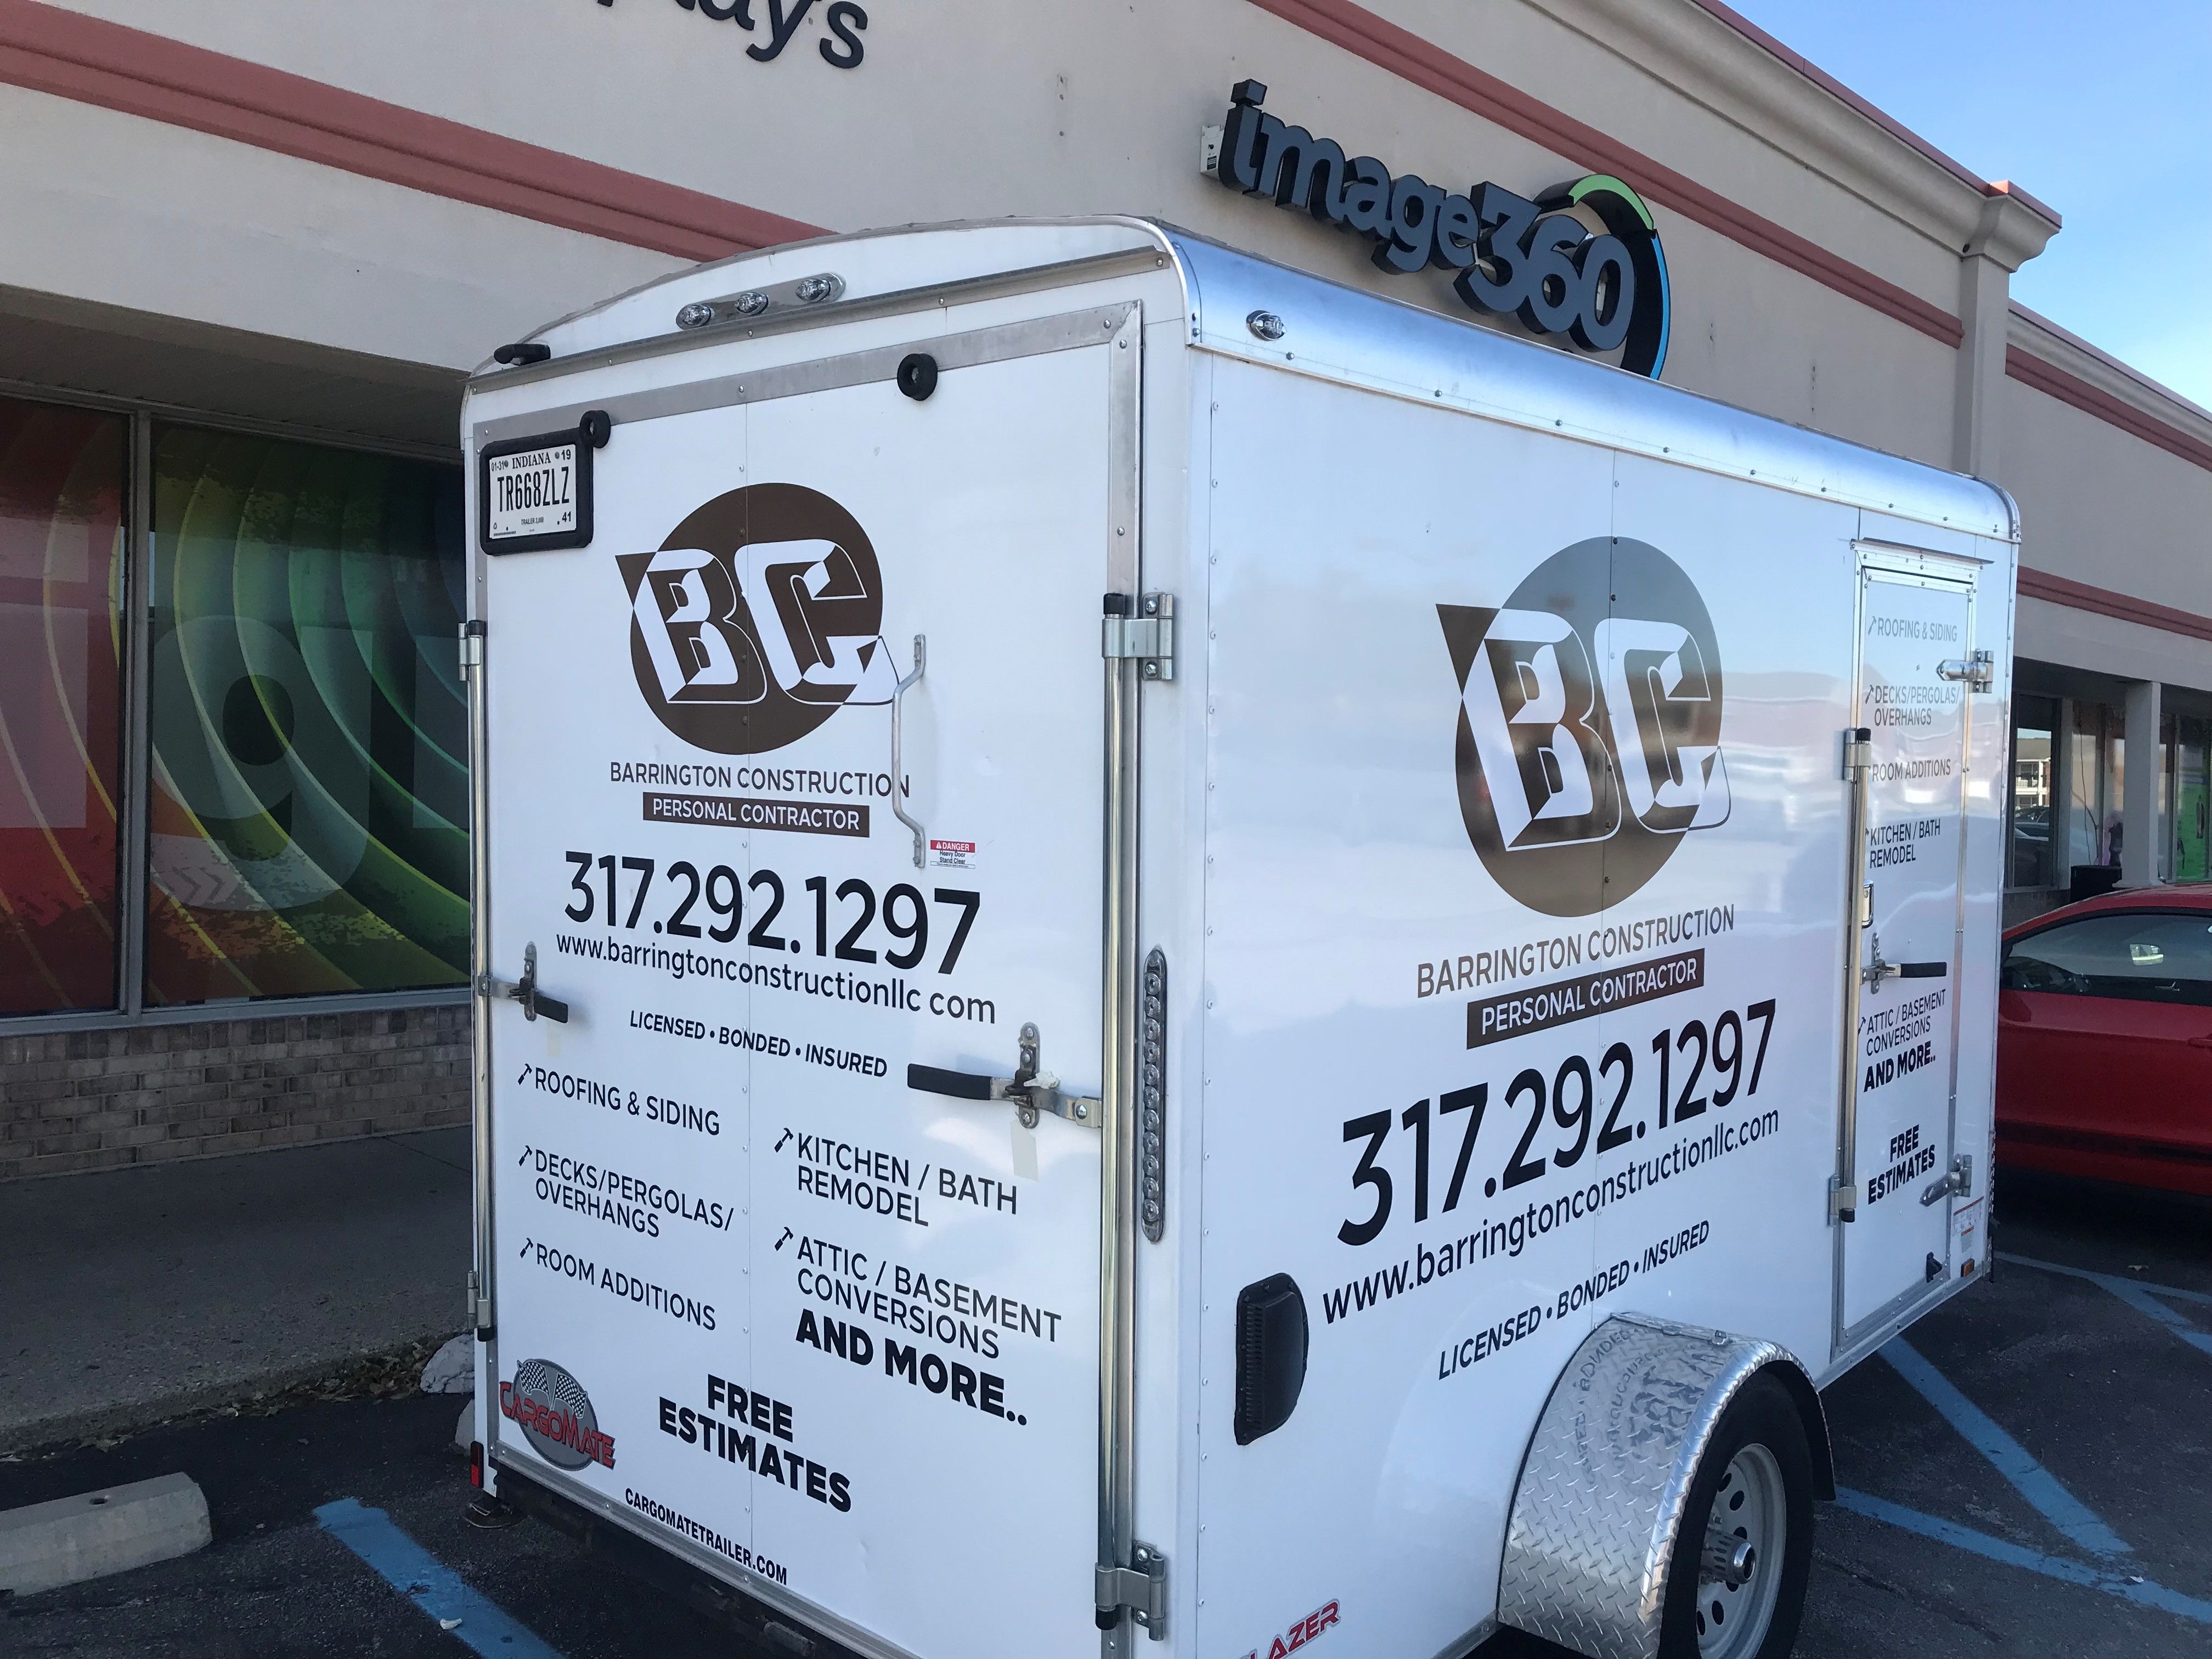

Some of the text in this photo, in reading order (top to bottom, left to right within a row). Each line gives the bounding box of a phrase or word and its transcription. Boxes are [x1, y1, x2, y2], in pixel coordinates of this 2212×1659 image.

[492, 449, 571, 472] 01-31 INDIANA 19
[498, 466, 569, 512] TR668ZLZ
[562, 511, 571, 522] 41
[1878, 617, 1957, 642] ROOFING & SIDING
[1875, 686, 1960, 704] DECKS/PERGOLAS/
[1875, 708, 1932, 726] OVERHANGS
[611, 761, 910, 798] BARRINGTON CONSTRUCTION
[1872, 759, 1950, 782] ROOM ADDITIONS
[652, 798, 859, 830] PERSONAL CONTRACTOR
[1871, 822, 1911, 845] KITCHEN
[1919, 819, 1940, 838] BATH
[943, 842, 969, 851] DANGER
[1870, 844, 1916, 868] REMODEL
[564, 850, 980, 975] 317.292.1297
[1418, 904, 1734, 998] BARRINGTON CONSTRUCTION
[1482, 958, 1697, 1035] PERSONAL CONTRACTOR
[1867, 1008, 1893, 1035] ATTIC
[1902, 989, 1946, 1022] BASEMENT
[630, 1010, 887, 1077] LICENSED BONDED INSURED
[1866, 1015, 1931, 1056] CONVERSIONS
[1864, 1041, 1936, 1093] AND MORE..
[535, 1067, 720, 1136] ROOFING & SIDING
[1337, 998, 1776, 1246] 317.292.1297
[799, 1132, 909, 1187] KITCHEN
[939, 1168, 1017, 1215] BATH
[1890, 1124, 1919, 1163] FREE
[535, 1149, 733, 1231] DECKS/PERGOLAS/
[798, 1165, 928, 1227] REMODEL
[1868, 1144, 1935, 1205] ESTIMATES
[535, 1178, 659, 1237] OVERHANGS
[1323, 1108, 1778, 1324] www.barringtonconstructionllc.com
[537, 1243, 715, 1330] ROOM ADDITIONS
[797, 1236, 867, 1280] ATTIC
[895, 1265, 1062, 1342] BASEMENT
[798, 1268, 999, 1358] CONVERSIONS
[1438, 1220, 1709, 1380] LICENSED BONDED INSURED
[795, 1308, 1027, 1426] AND MORE..
[708, 1374, 793, 1442] FREE
[659, 1396, 851, 1513] ESTIMATES
[625, 1488, 787, 1585] CARGOMATETRAILER.COM
[1249, 1598, 1340, 1659] AZER
